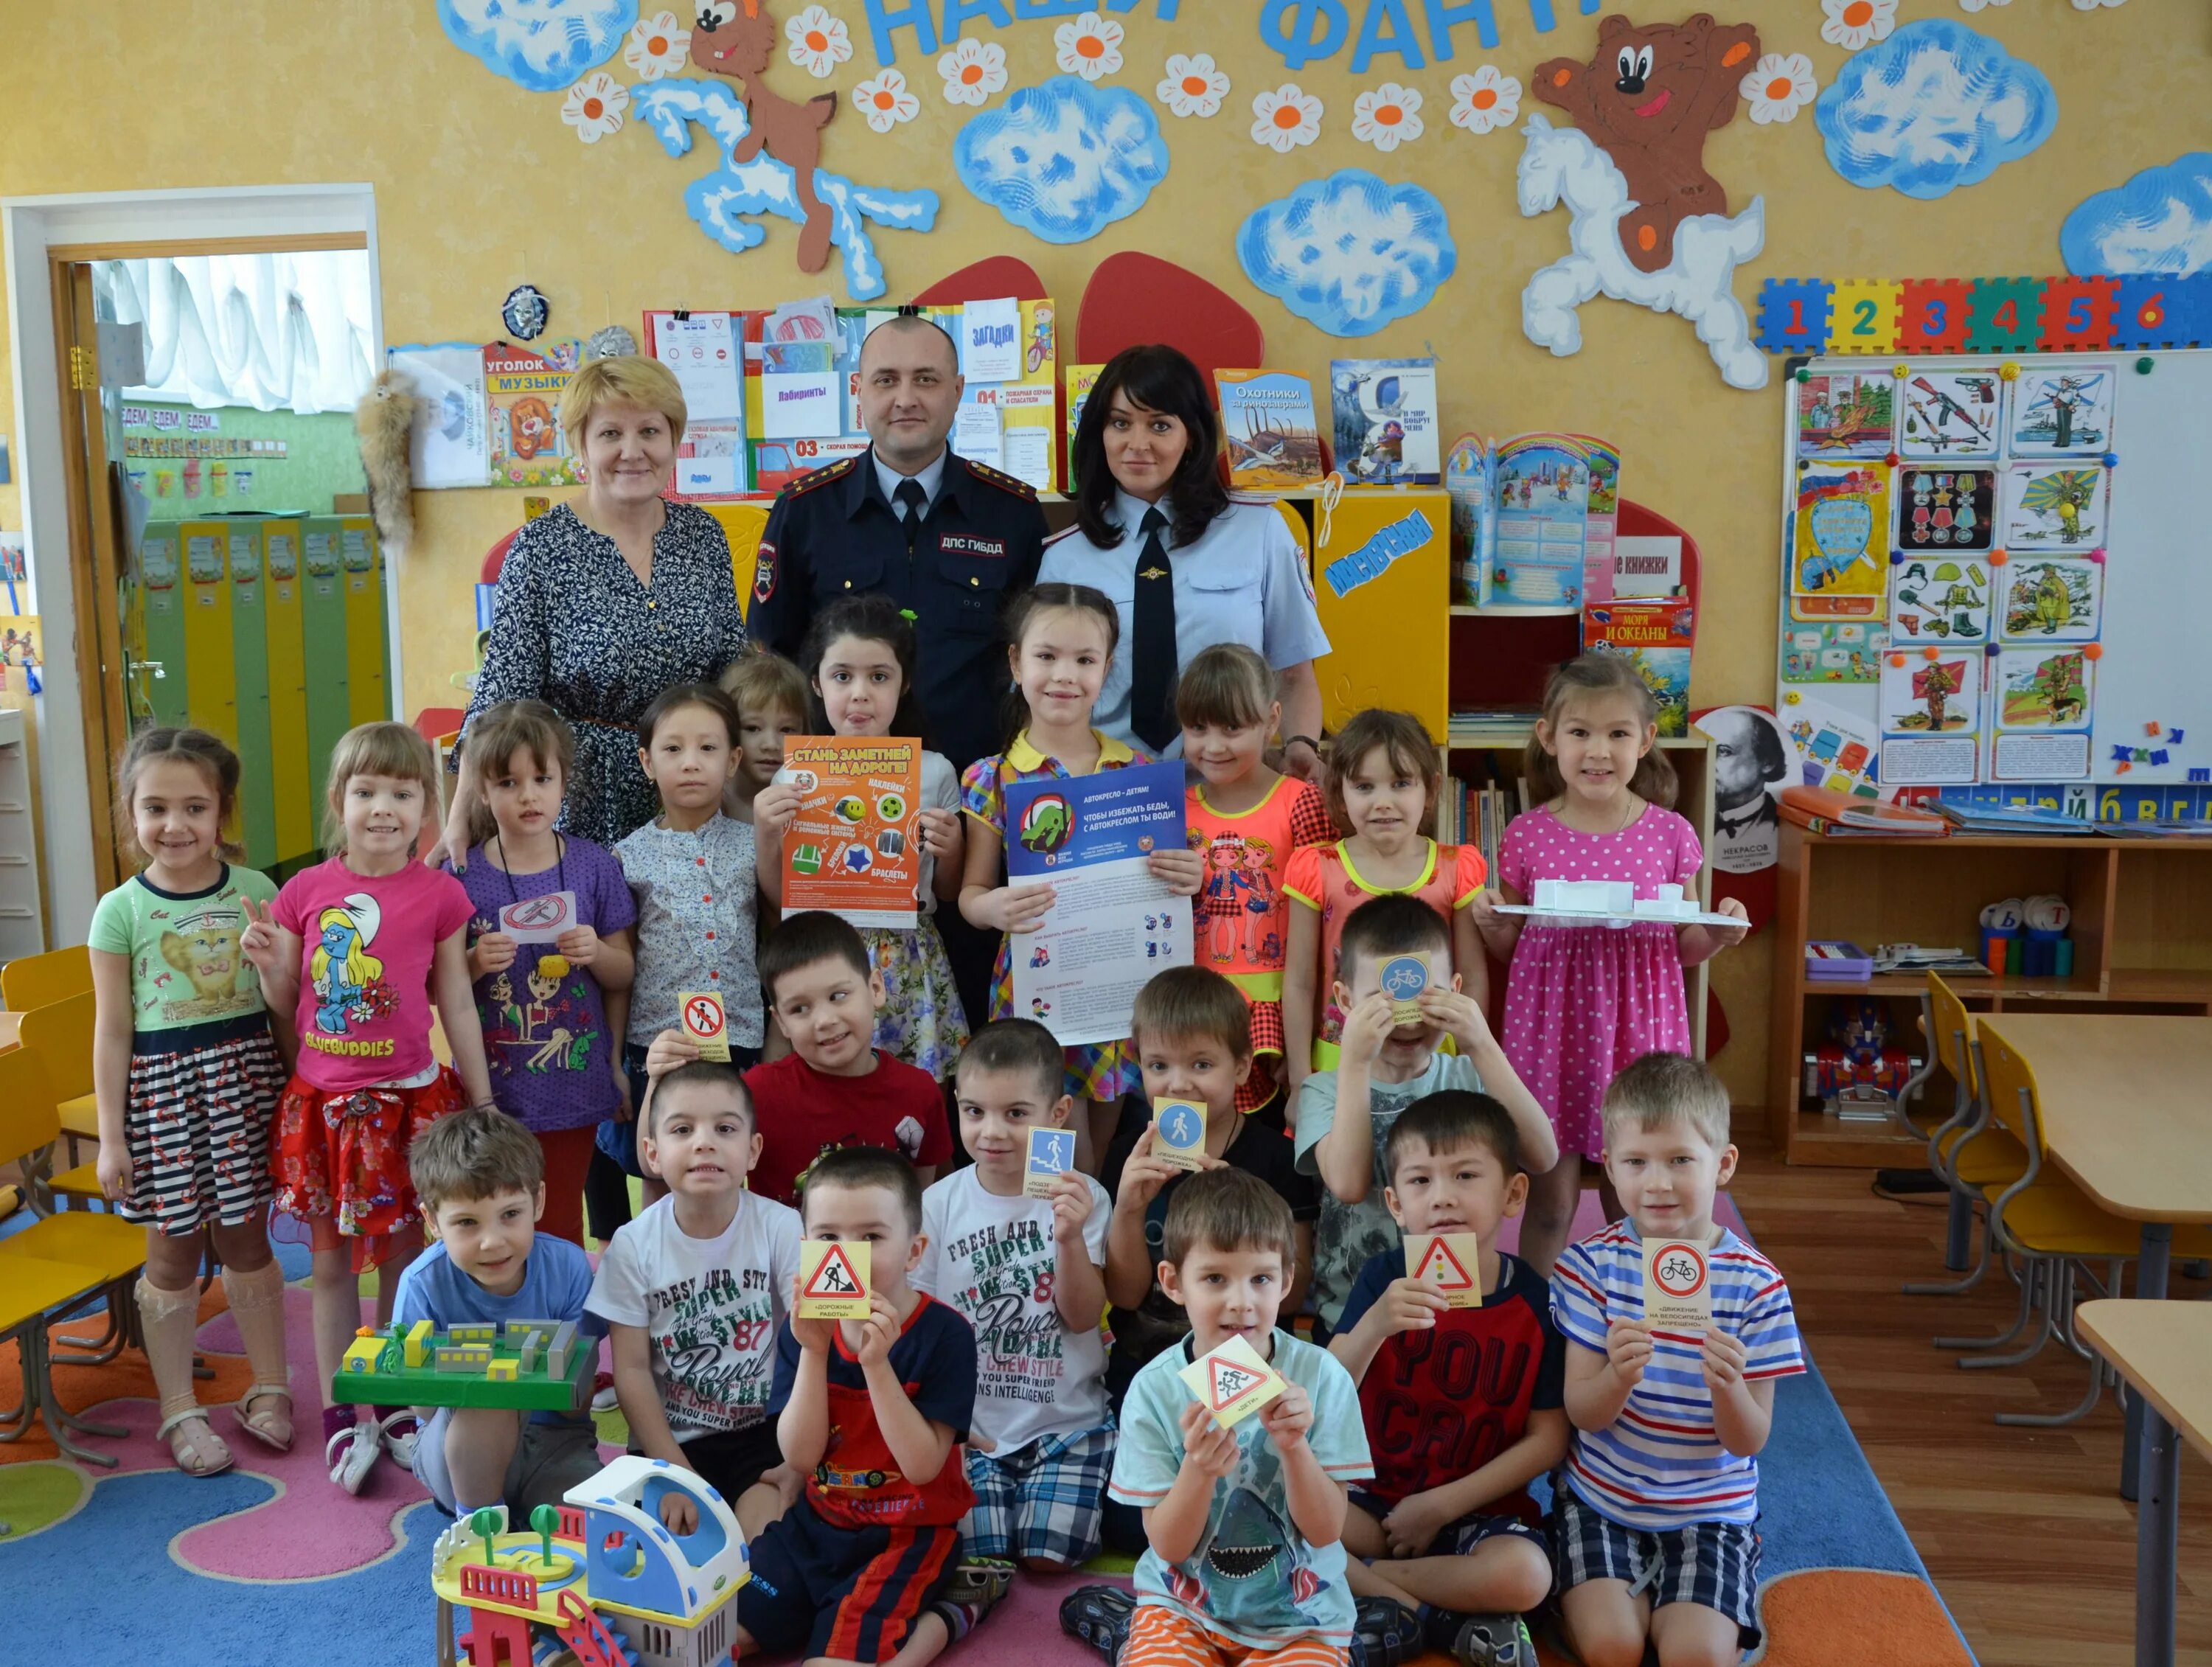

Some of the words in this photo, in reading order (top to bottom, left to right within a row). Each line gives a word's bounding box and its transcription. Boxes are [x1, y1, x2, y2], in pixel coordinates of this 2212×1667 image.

[1784, 300, 1808, 335] 1
[1851, 299, 1877, 335] 2
[1921, 300, 1947, 336] 3
[1992, 299, 2020, 335] 4
[2065, 297, 2093, 334] 5
[2138, 292, 2165, 329] 6
[973, 324, 1014, 348] ЗАГАДКИ
[487, 359, 544, 372] УГОЛОК
[779, 387, 827, 402] Лабиринты
[1236, 386, 1301, 399] Охотники
[796, 440, 818, 457] 03
[942, 537, 965, 549] ДПС
[968, 539, 1004, 554] ГИБДД
[1623, 614, 1649, 625] МОРЯ
[1606, 627, 1615, 639] И
[1617, 627, 1667, 640] ОКЕАНЫ
[793, 748, 838, 762] СТАНЬ
[840, 745, 912, 761] ЗАМЕТНЕЙ
[830, 762, 849, 775] НА
[850, 762, 908, 776] ДОРОГЕ!
[868, 778, 905, 793] НАКЛЕЙКИ
[1083, 790, 1121, 804] АВТОКРЕСЛО
[1126, 786, 1150, 797] ДЕТЯМ!
[1083, 811, 1107, 822] ЧТОБЫ
[1108, 804, 1145, 818] ИЗБЕЖАТЬ
[1147, 801, 1169, 812] БЕДЫ,
[1089, 816, 1139, 832] АВТОКРЕСЛОМ
[1152, 810, 1176, 820] ВОДИ!
[827, 841, 847, 869] БРЕЛОКИ
[1722, 843, 1768, 855] НЕКРАСОВ
[871, 869, 908, 880] БРАСЛЕТЫ
[305, 1031, 395, 1058] BLUEBUDDIES
[947, 1225, 997, 1262] FRESH
[1006, 1219, 1038, 1241] AND
[971, 1230, 1046, 1276] SUPER
[703, 1268, 731, 1290] AND
[732, 1320, 771, 1351] 87
[670, 1336, 773, 1403] Royal
[1388, 1326, 1531, 1407] YOU
[982, 1372, 1003, 1384] YOU
[1004, 1373, 1031, 1385] SUPER
[1032, 1376, 1056, 1389] FRIEND
[664, 1400, 681, 1415] AND
[681, 1406, 700, 1419] YOU
[701, 1412, 731, 1428] SUPER
